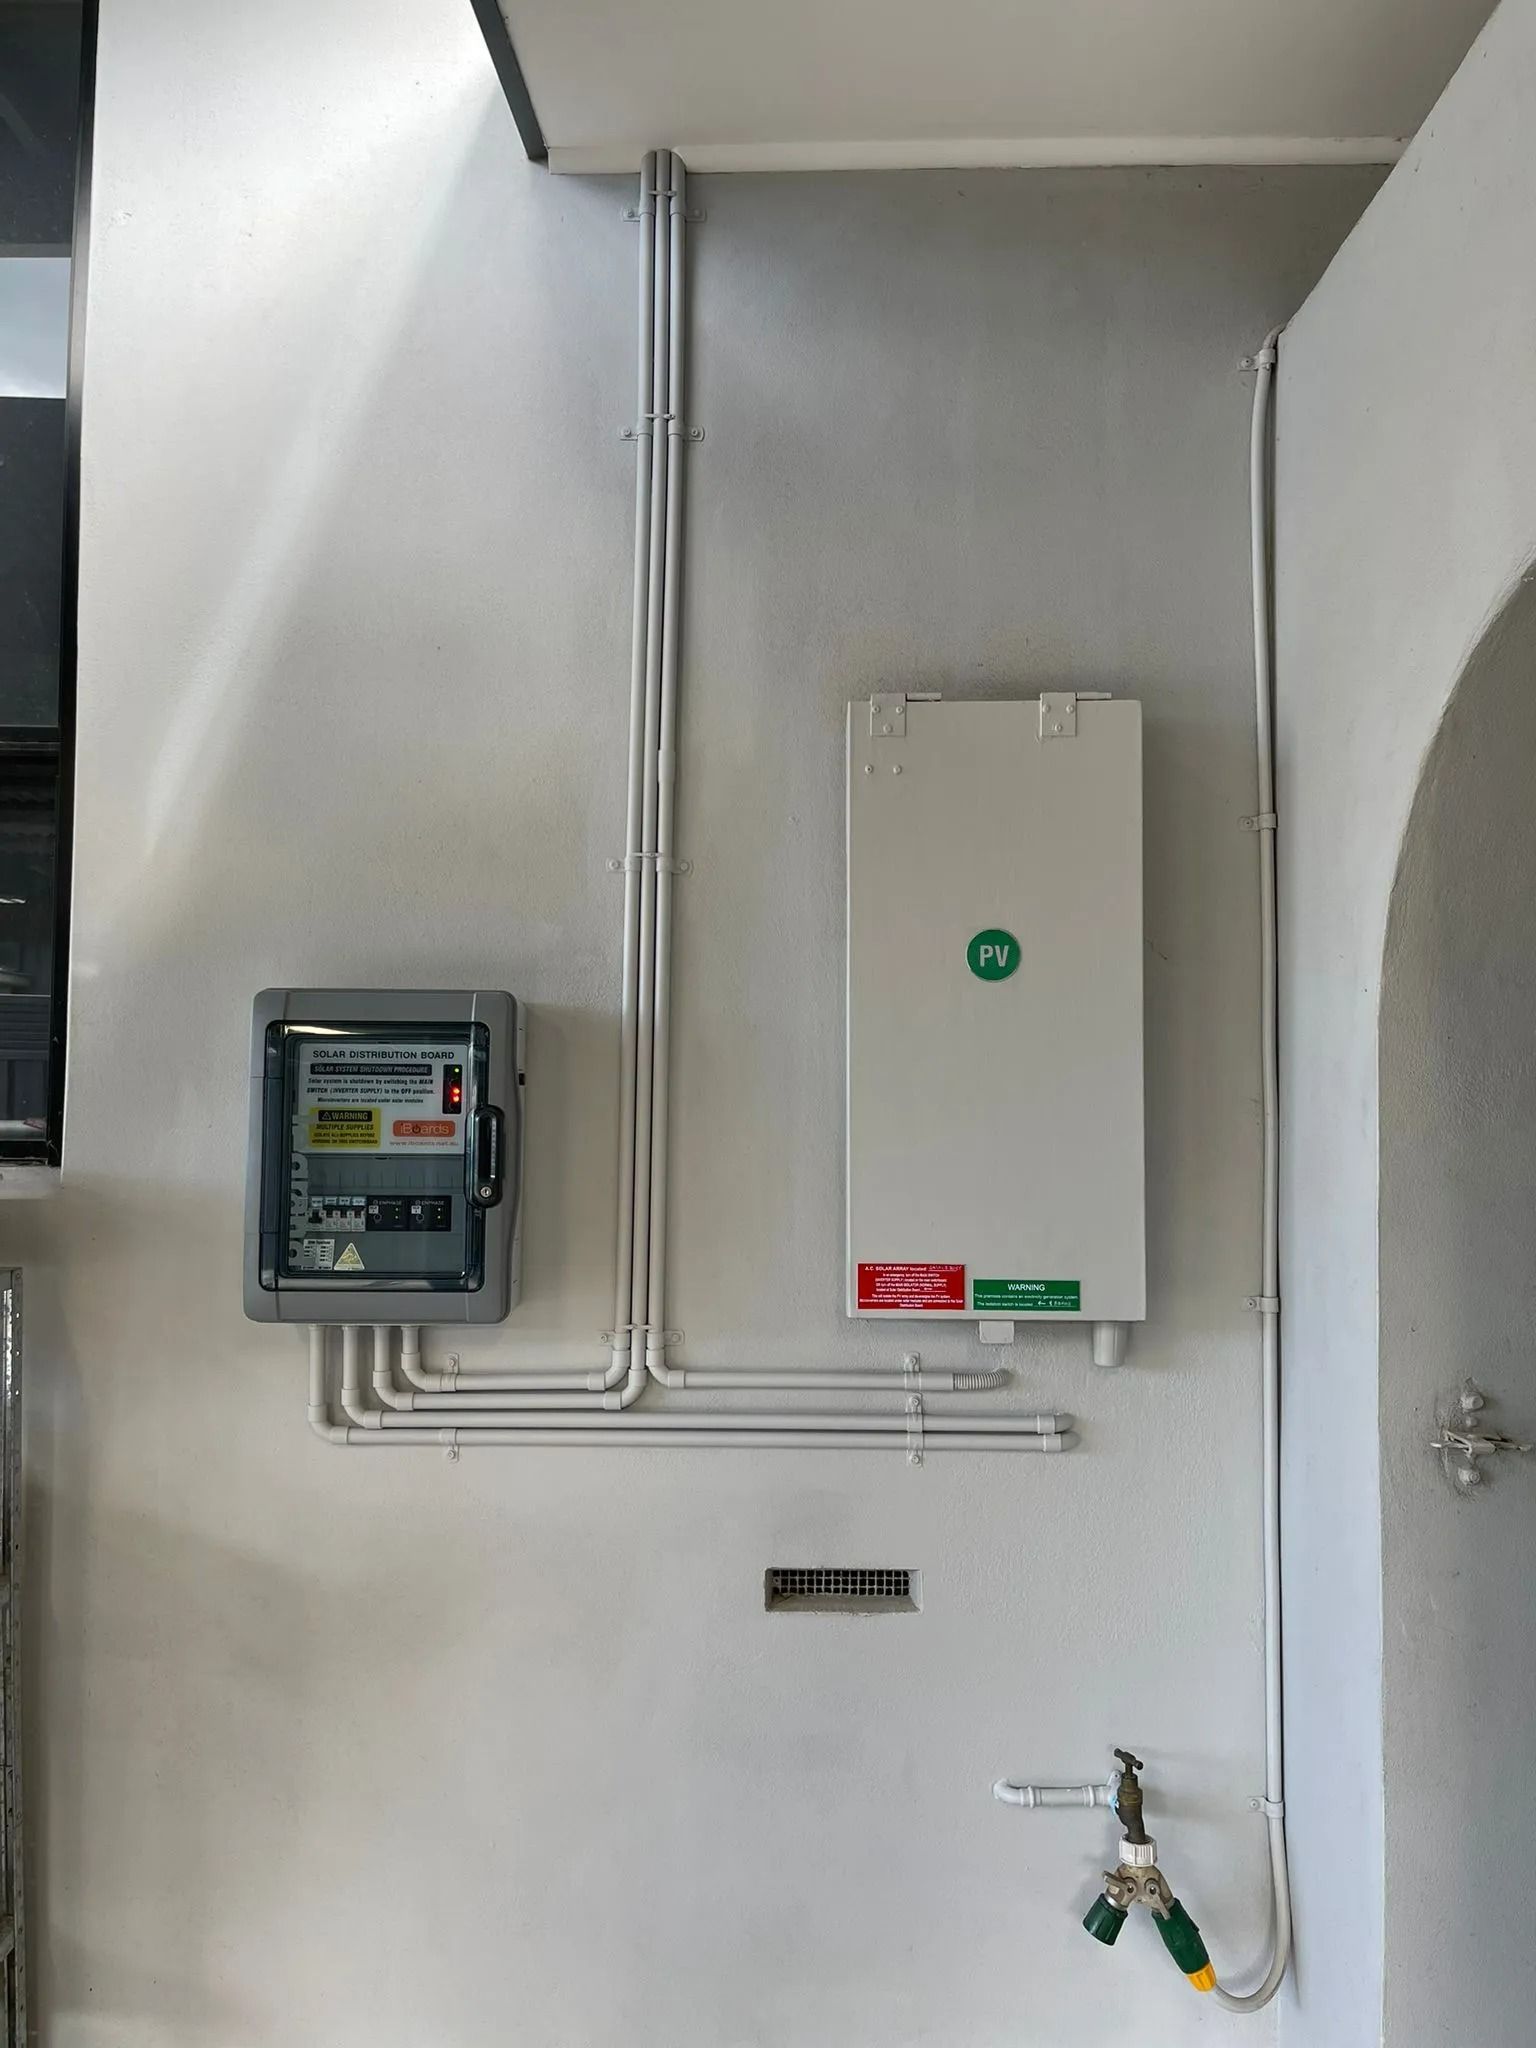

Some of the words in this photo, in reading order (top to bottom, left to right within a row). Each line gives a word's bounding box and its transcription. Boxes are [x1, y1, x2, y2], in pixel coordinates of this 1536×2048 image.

[980, 944, 1009, 967] PV
[312, 1050, 346, 1058] SOLAR
[350, 1051, 417, 1059] DISTRIBUTION
[332, 1112, 368, 1120] WARNING
[400, 1122, 450, 1134] iBoards
